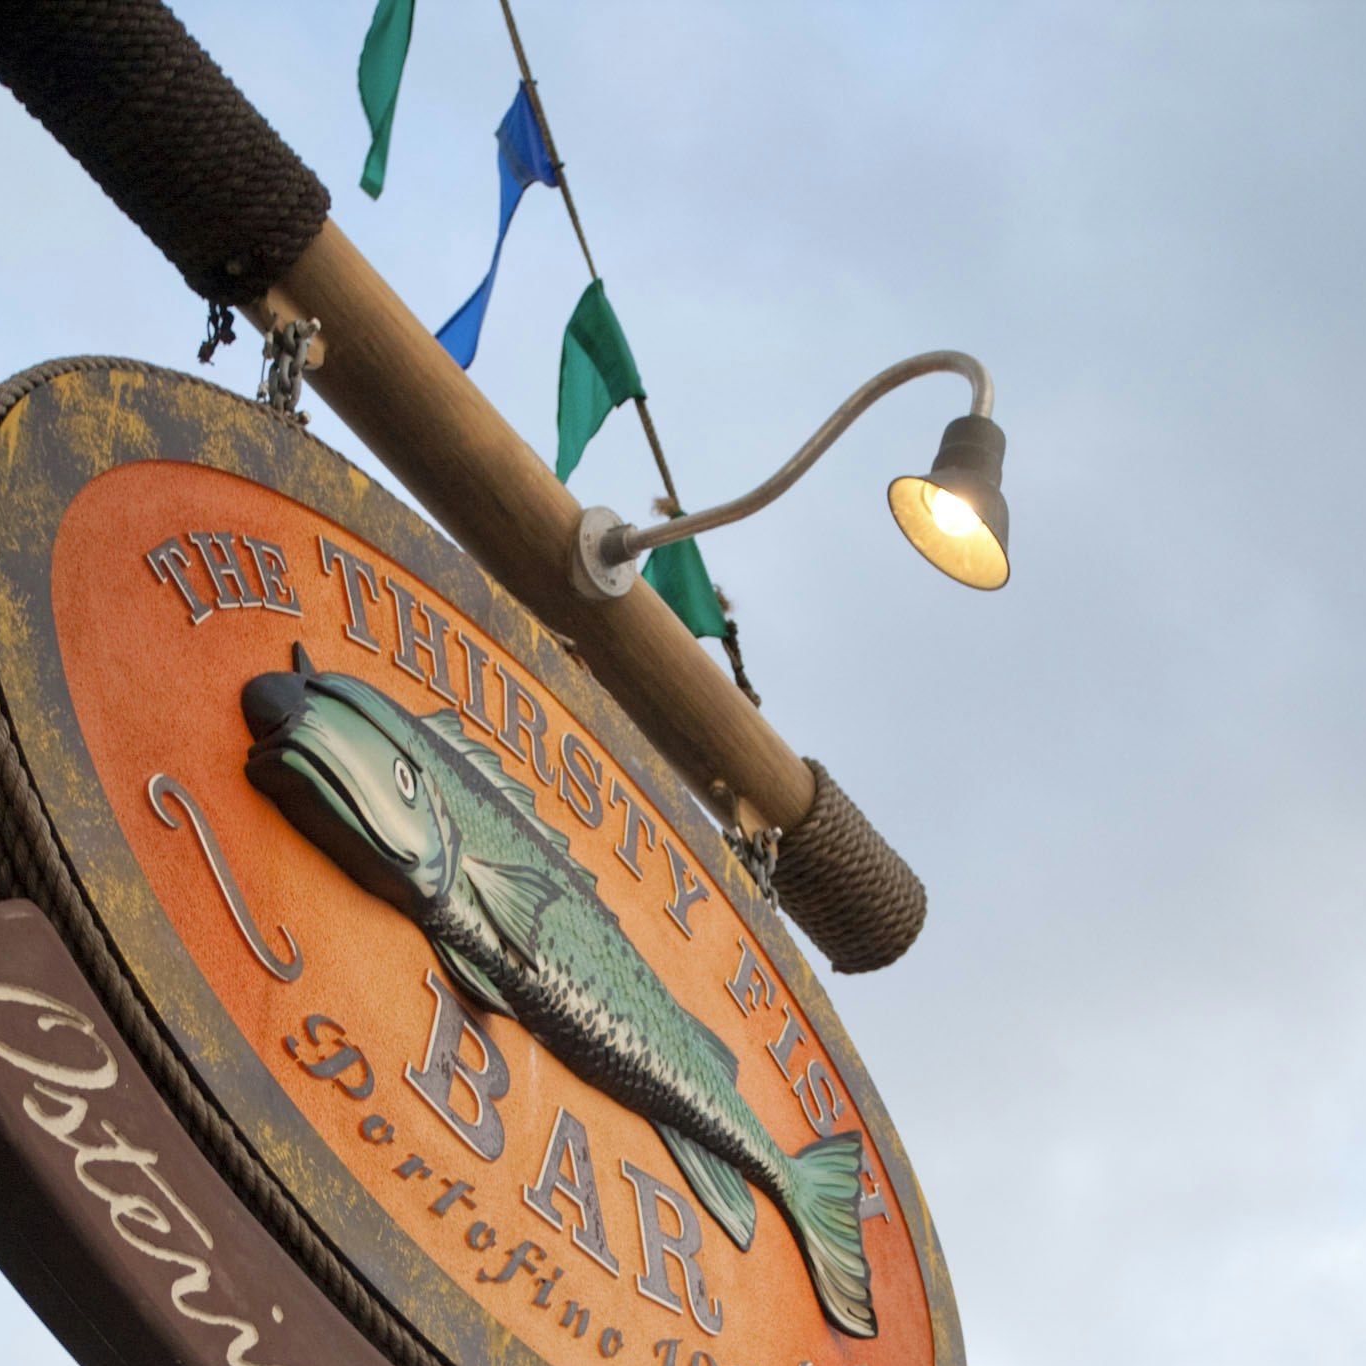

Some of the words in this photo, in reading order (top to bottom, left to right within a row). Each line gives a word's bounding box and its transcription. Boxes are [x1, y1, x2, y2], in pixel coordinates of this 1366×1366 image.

[146, 531, 303, 624] THE
[318, 534, 710, 940] THIRSTY
[281, 1012, 623, 1357] Portofino
[405, 969, 723, 1336] BAR
